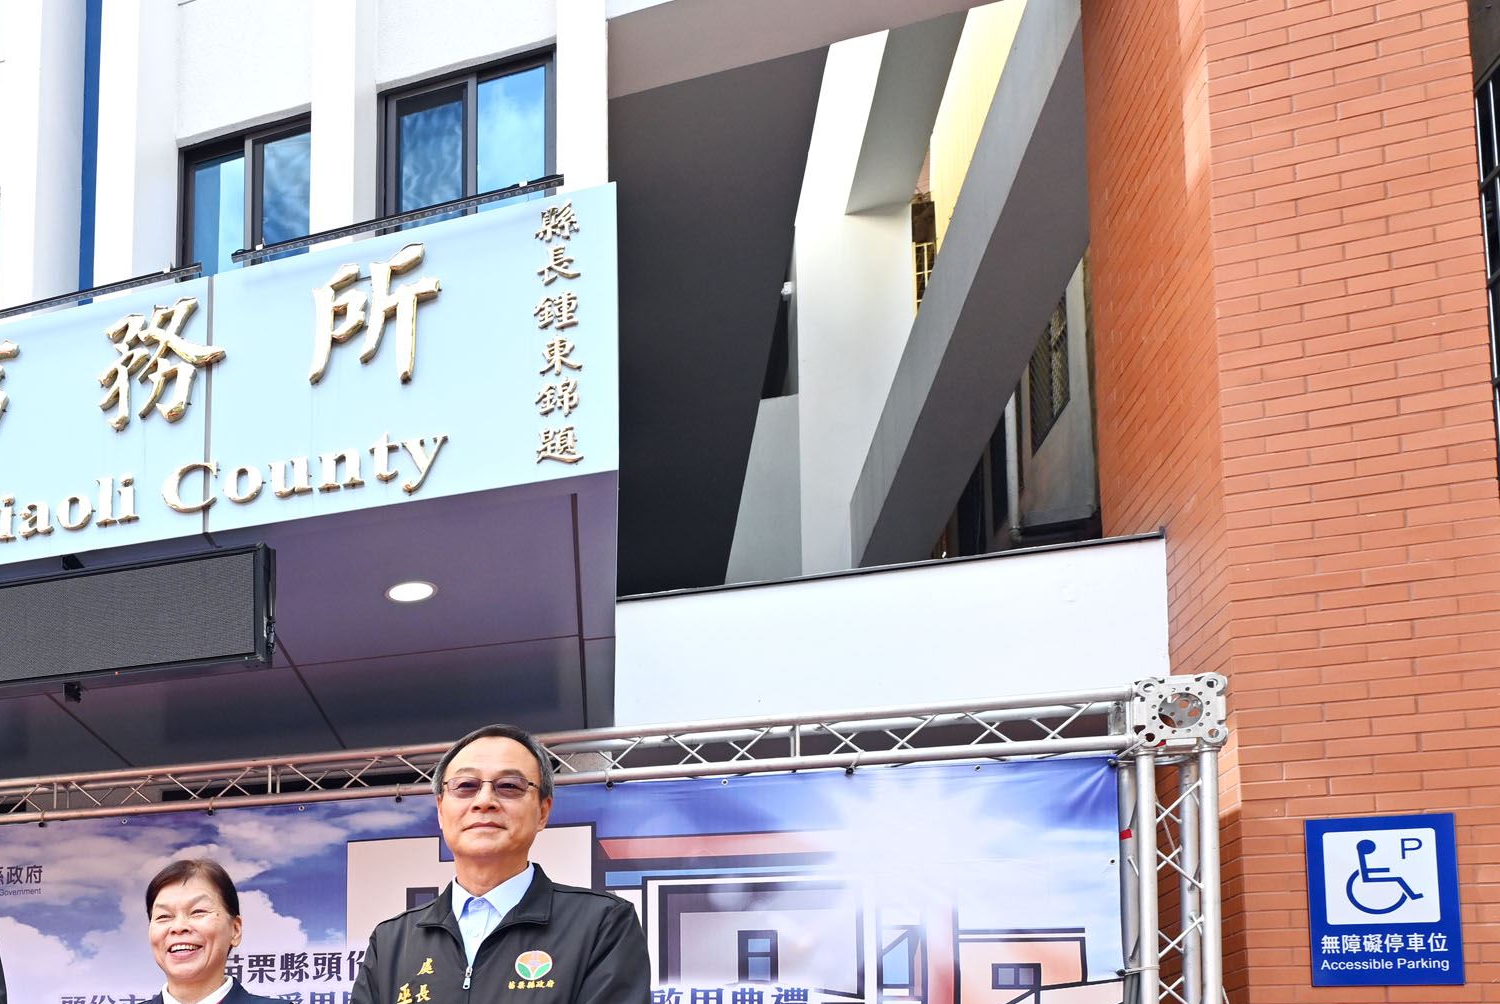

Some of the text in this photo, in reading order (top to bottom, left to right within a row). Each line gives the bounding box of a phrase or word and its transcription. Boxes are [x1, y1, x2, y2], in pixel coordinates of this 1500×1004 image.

[162, 433, 449, 513] County
[1400, 837, 1423, 860] P
[1321, 932, 1449, 954] 無障礙停車位
[1321, 957, 1450, 972] Accessible Parking
